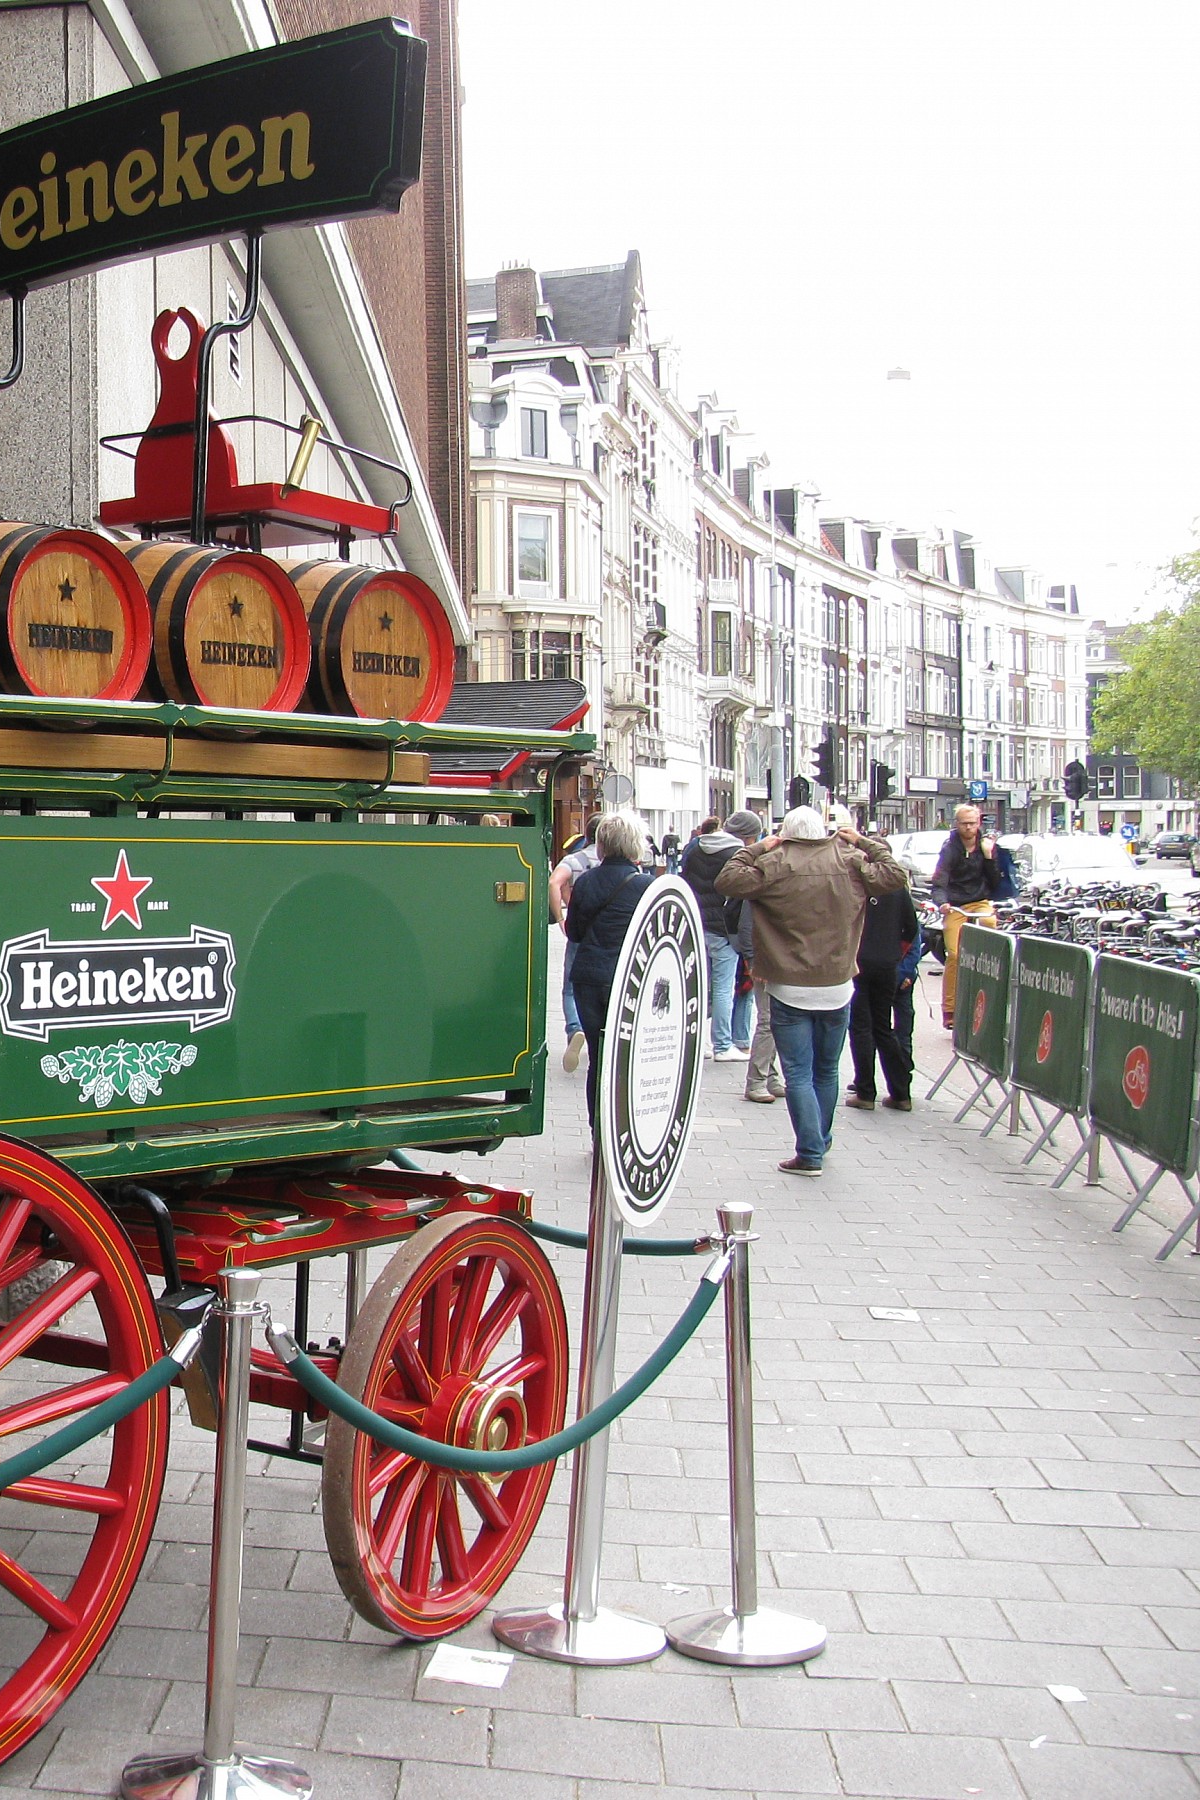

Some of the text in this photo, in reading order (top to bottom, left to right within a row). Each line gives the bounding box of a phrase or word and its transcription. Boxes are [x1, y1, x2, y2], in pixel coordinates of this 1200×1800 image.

[200, 640, 276, 669] HEINEKEN
[353, 651, 420, 678] HEINEKEN
[71, 901, 169, 912] TRADE MARK
[620, 904, 688, 1041] HEINEKEN
